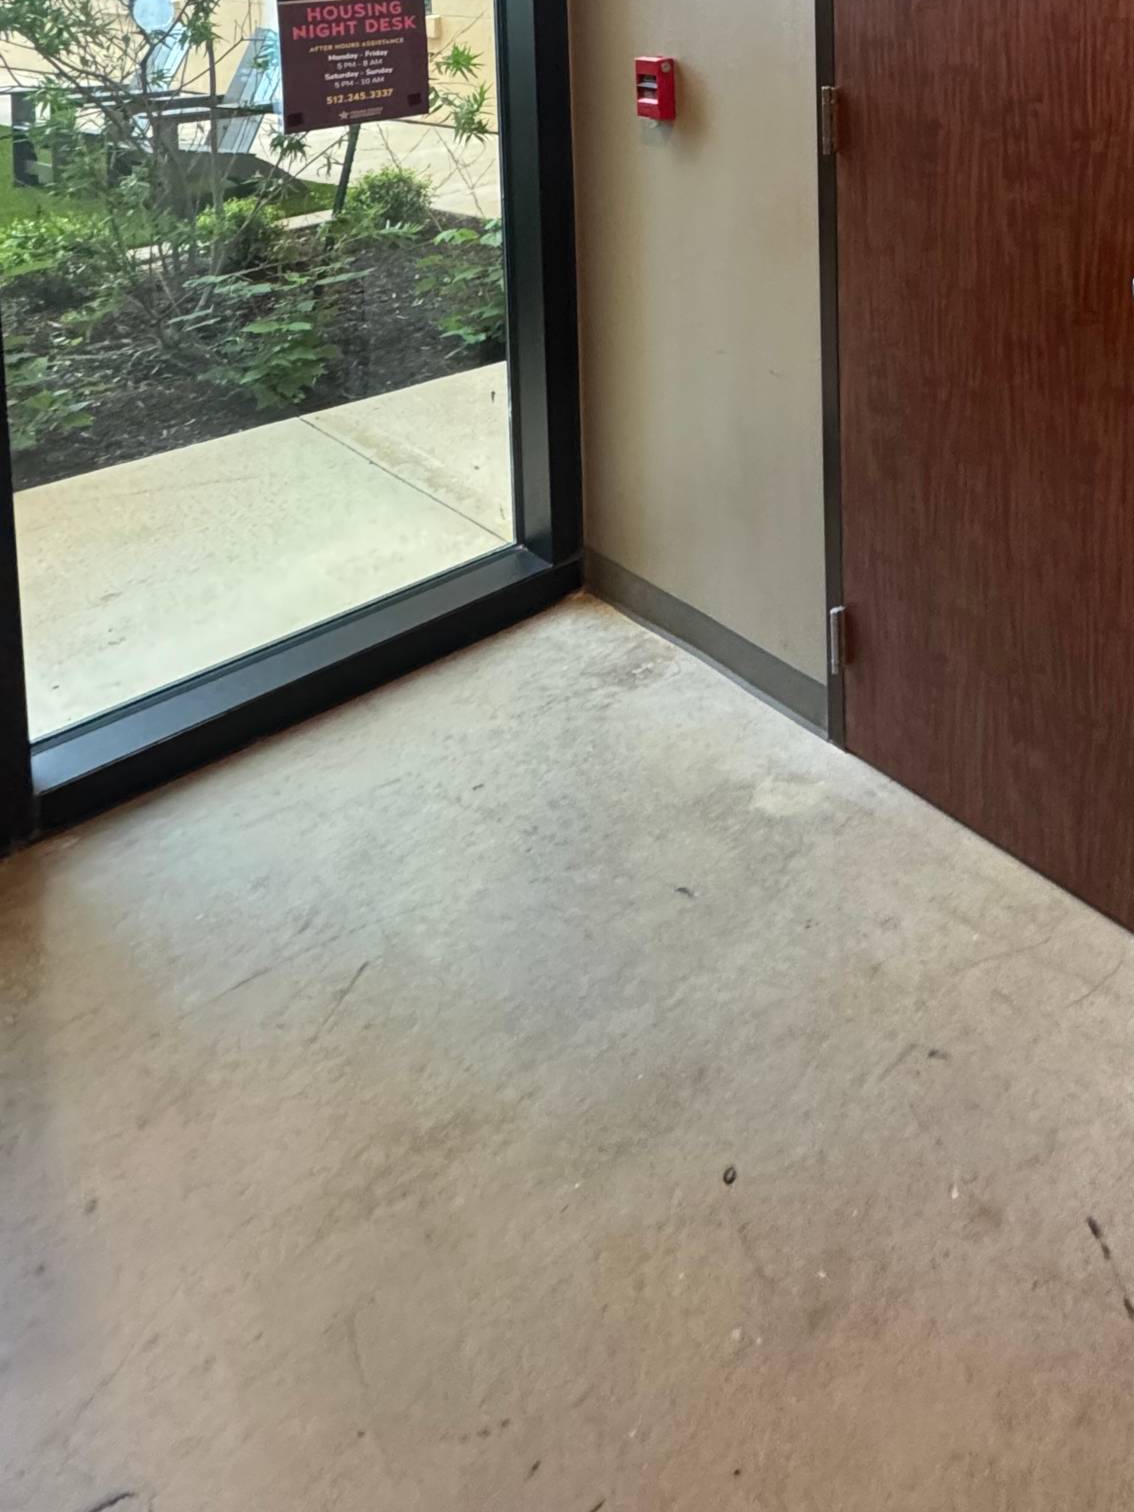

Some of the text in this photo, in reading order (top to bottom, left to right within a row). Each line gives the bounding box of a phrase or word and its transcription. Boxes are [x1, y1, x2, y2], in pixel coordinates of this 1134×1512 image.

[307, 1, 402, 22] HOUSING
[292, 15, 416, 40] NIGHT DESK
[308, 37, 404, 53] AFTER HOURS ASSISTANCE
[328, 52, 358, 62] Monday
[365, 50, 388, 58] Friday
[324, 71, 359, 81] Saturday
[366, 67, 393, 76] Sunday
